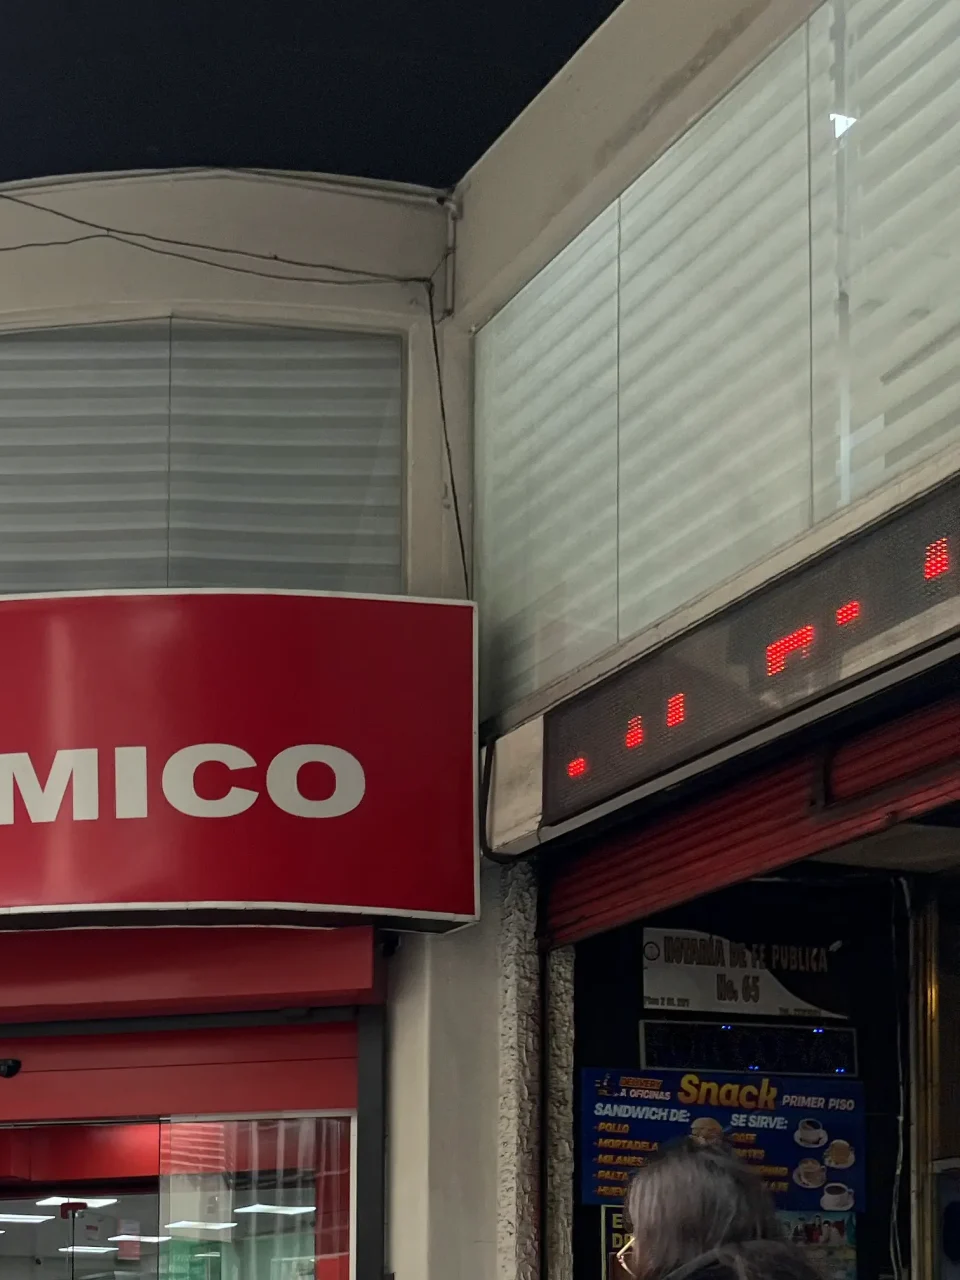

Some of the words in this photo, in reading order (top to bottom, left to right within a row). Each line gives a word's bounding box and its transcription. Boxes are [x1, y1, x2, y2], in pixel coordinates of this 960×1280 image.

[629, 1089, 671, 1101] OFICINAS
[677, 1072, 778, 1111] Snack
[782, 1095, 825, 1109] PRIMER
[828, 1099, 855, 1111] PISO
[593, 1102, 669, 1121] SANDWICH
[669, 1109, 691, 1123] DE:
[730, 1113, 747, 1127] SE
[748, 1115, 789, 1130] SIRVE:
